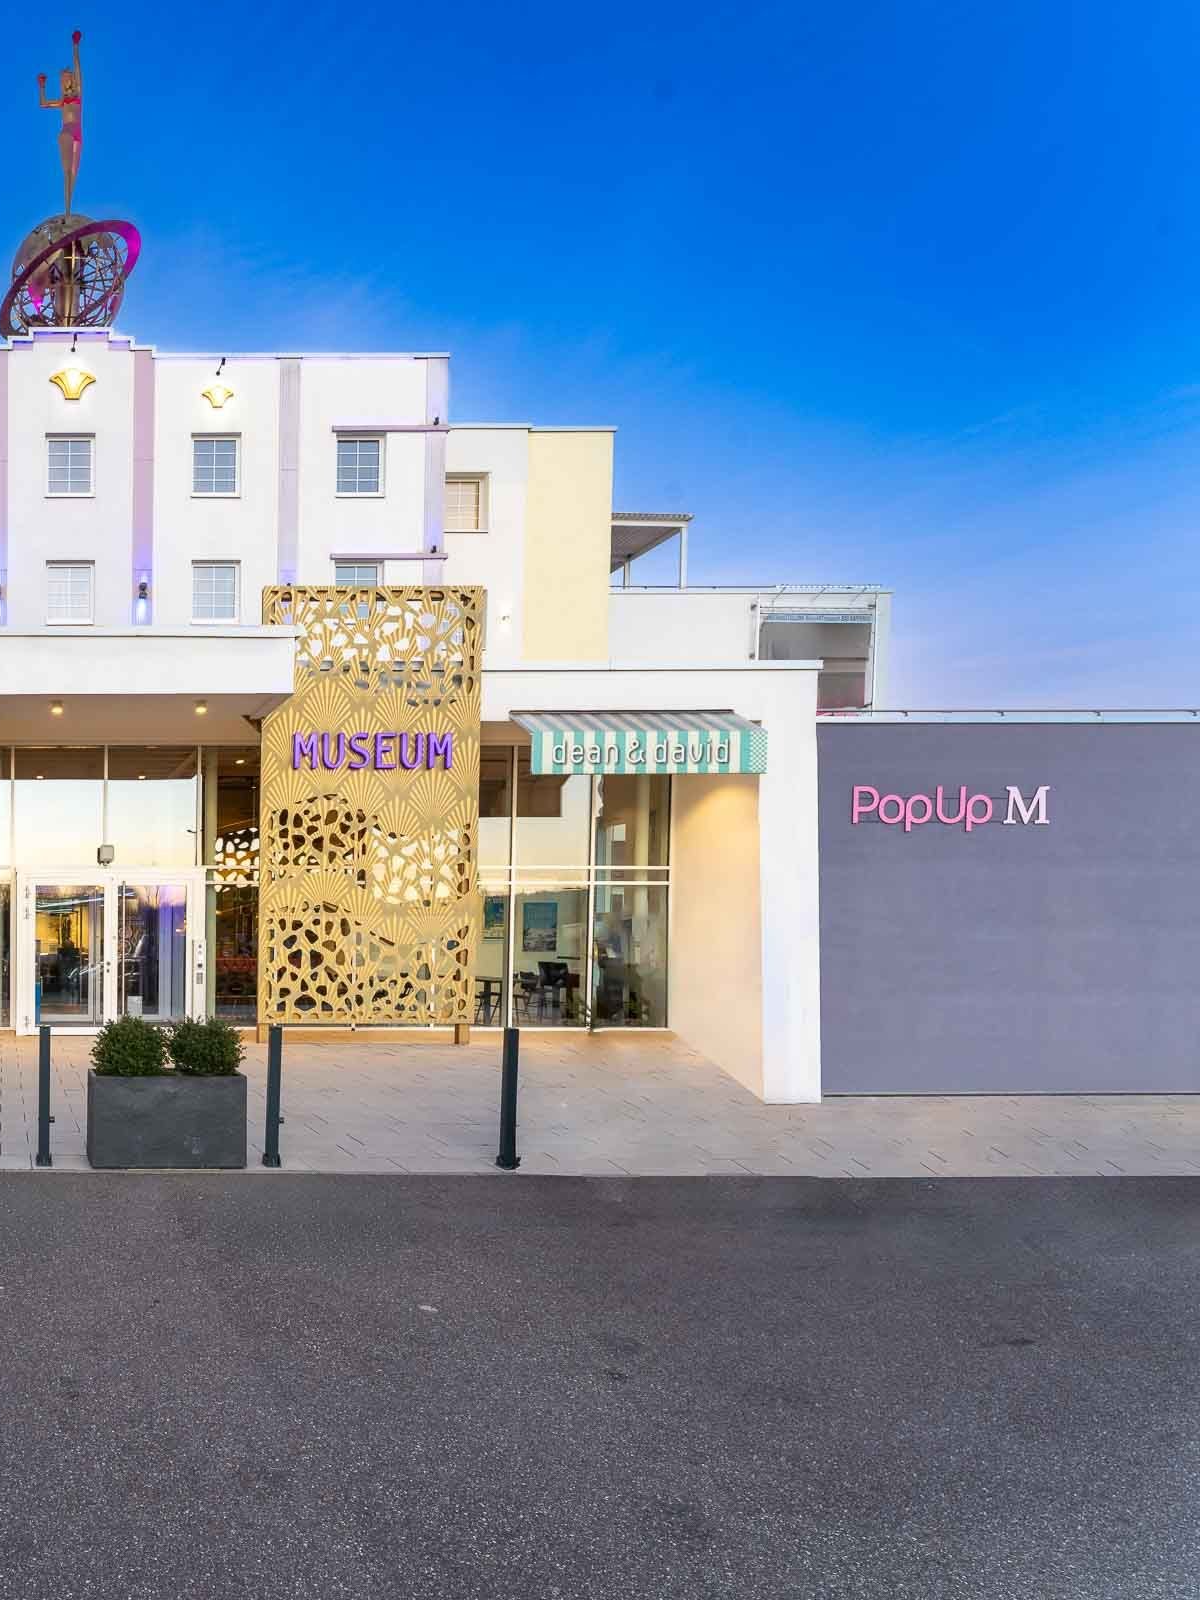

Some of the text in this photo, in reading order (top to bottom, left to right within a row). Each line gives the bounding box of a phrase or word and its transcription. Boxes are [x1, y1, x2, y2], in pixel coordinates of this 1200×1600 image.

[291, 731, 454, 770] MUSEUM
[851, 784, 1051, 832] PopUp M
